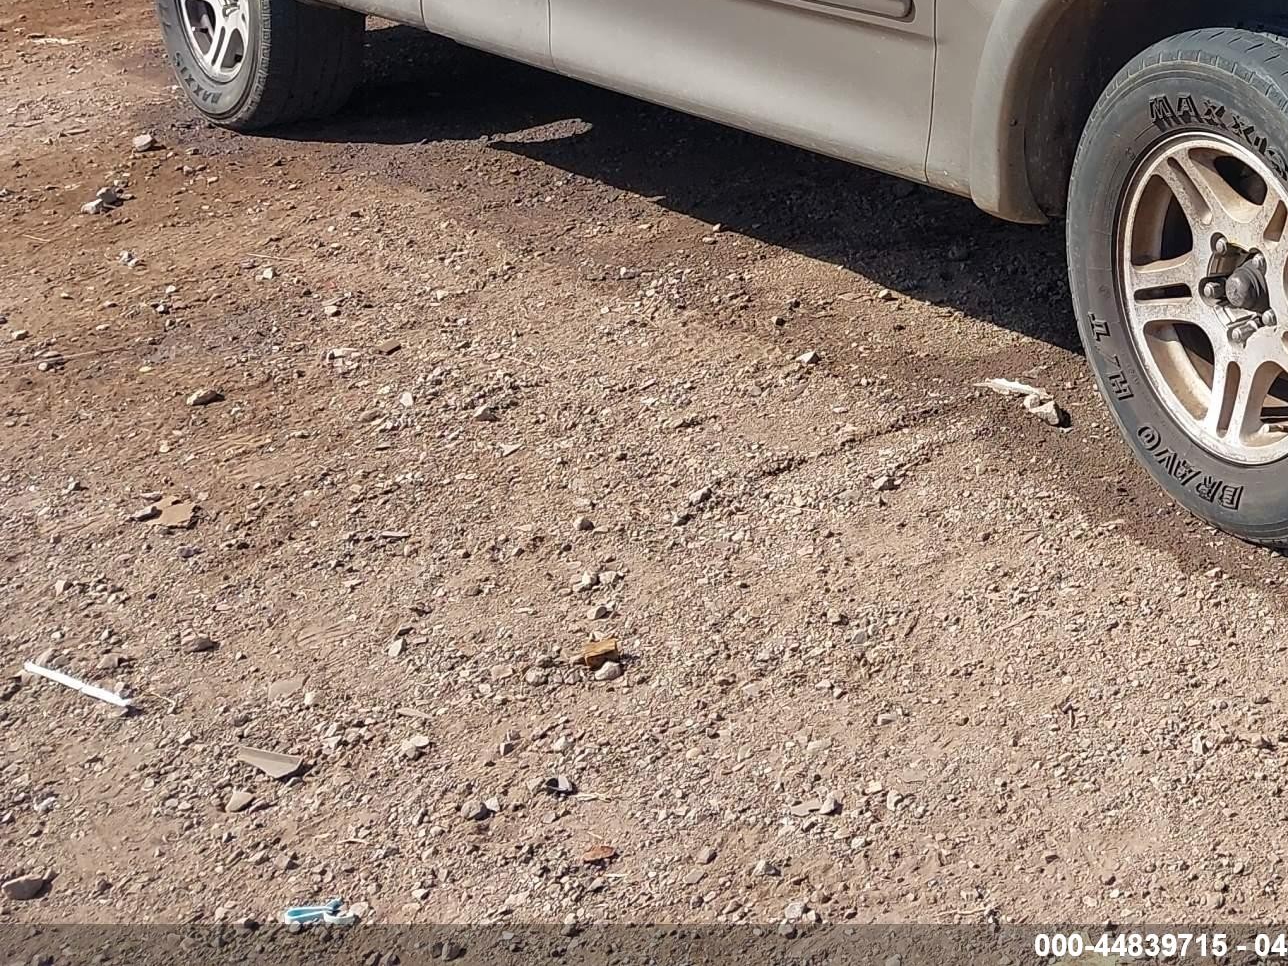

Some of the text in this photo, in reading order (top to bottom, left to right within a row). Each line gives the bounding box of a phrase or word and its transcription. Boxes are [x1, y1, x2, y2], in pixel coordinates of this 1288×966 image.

[173, 52, 223, 105] MAXXIS
[1148, 94, 1288, 183] MAXXIS
[1136, 424, 1246, 512] BRAVO
